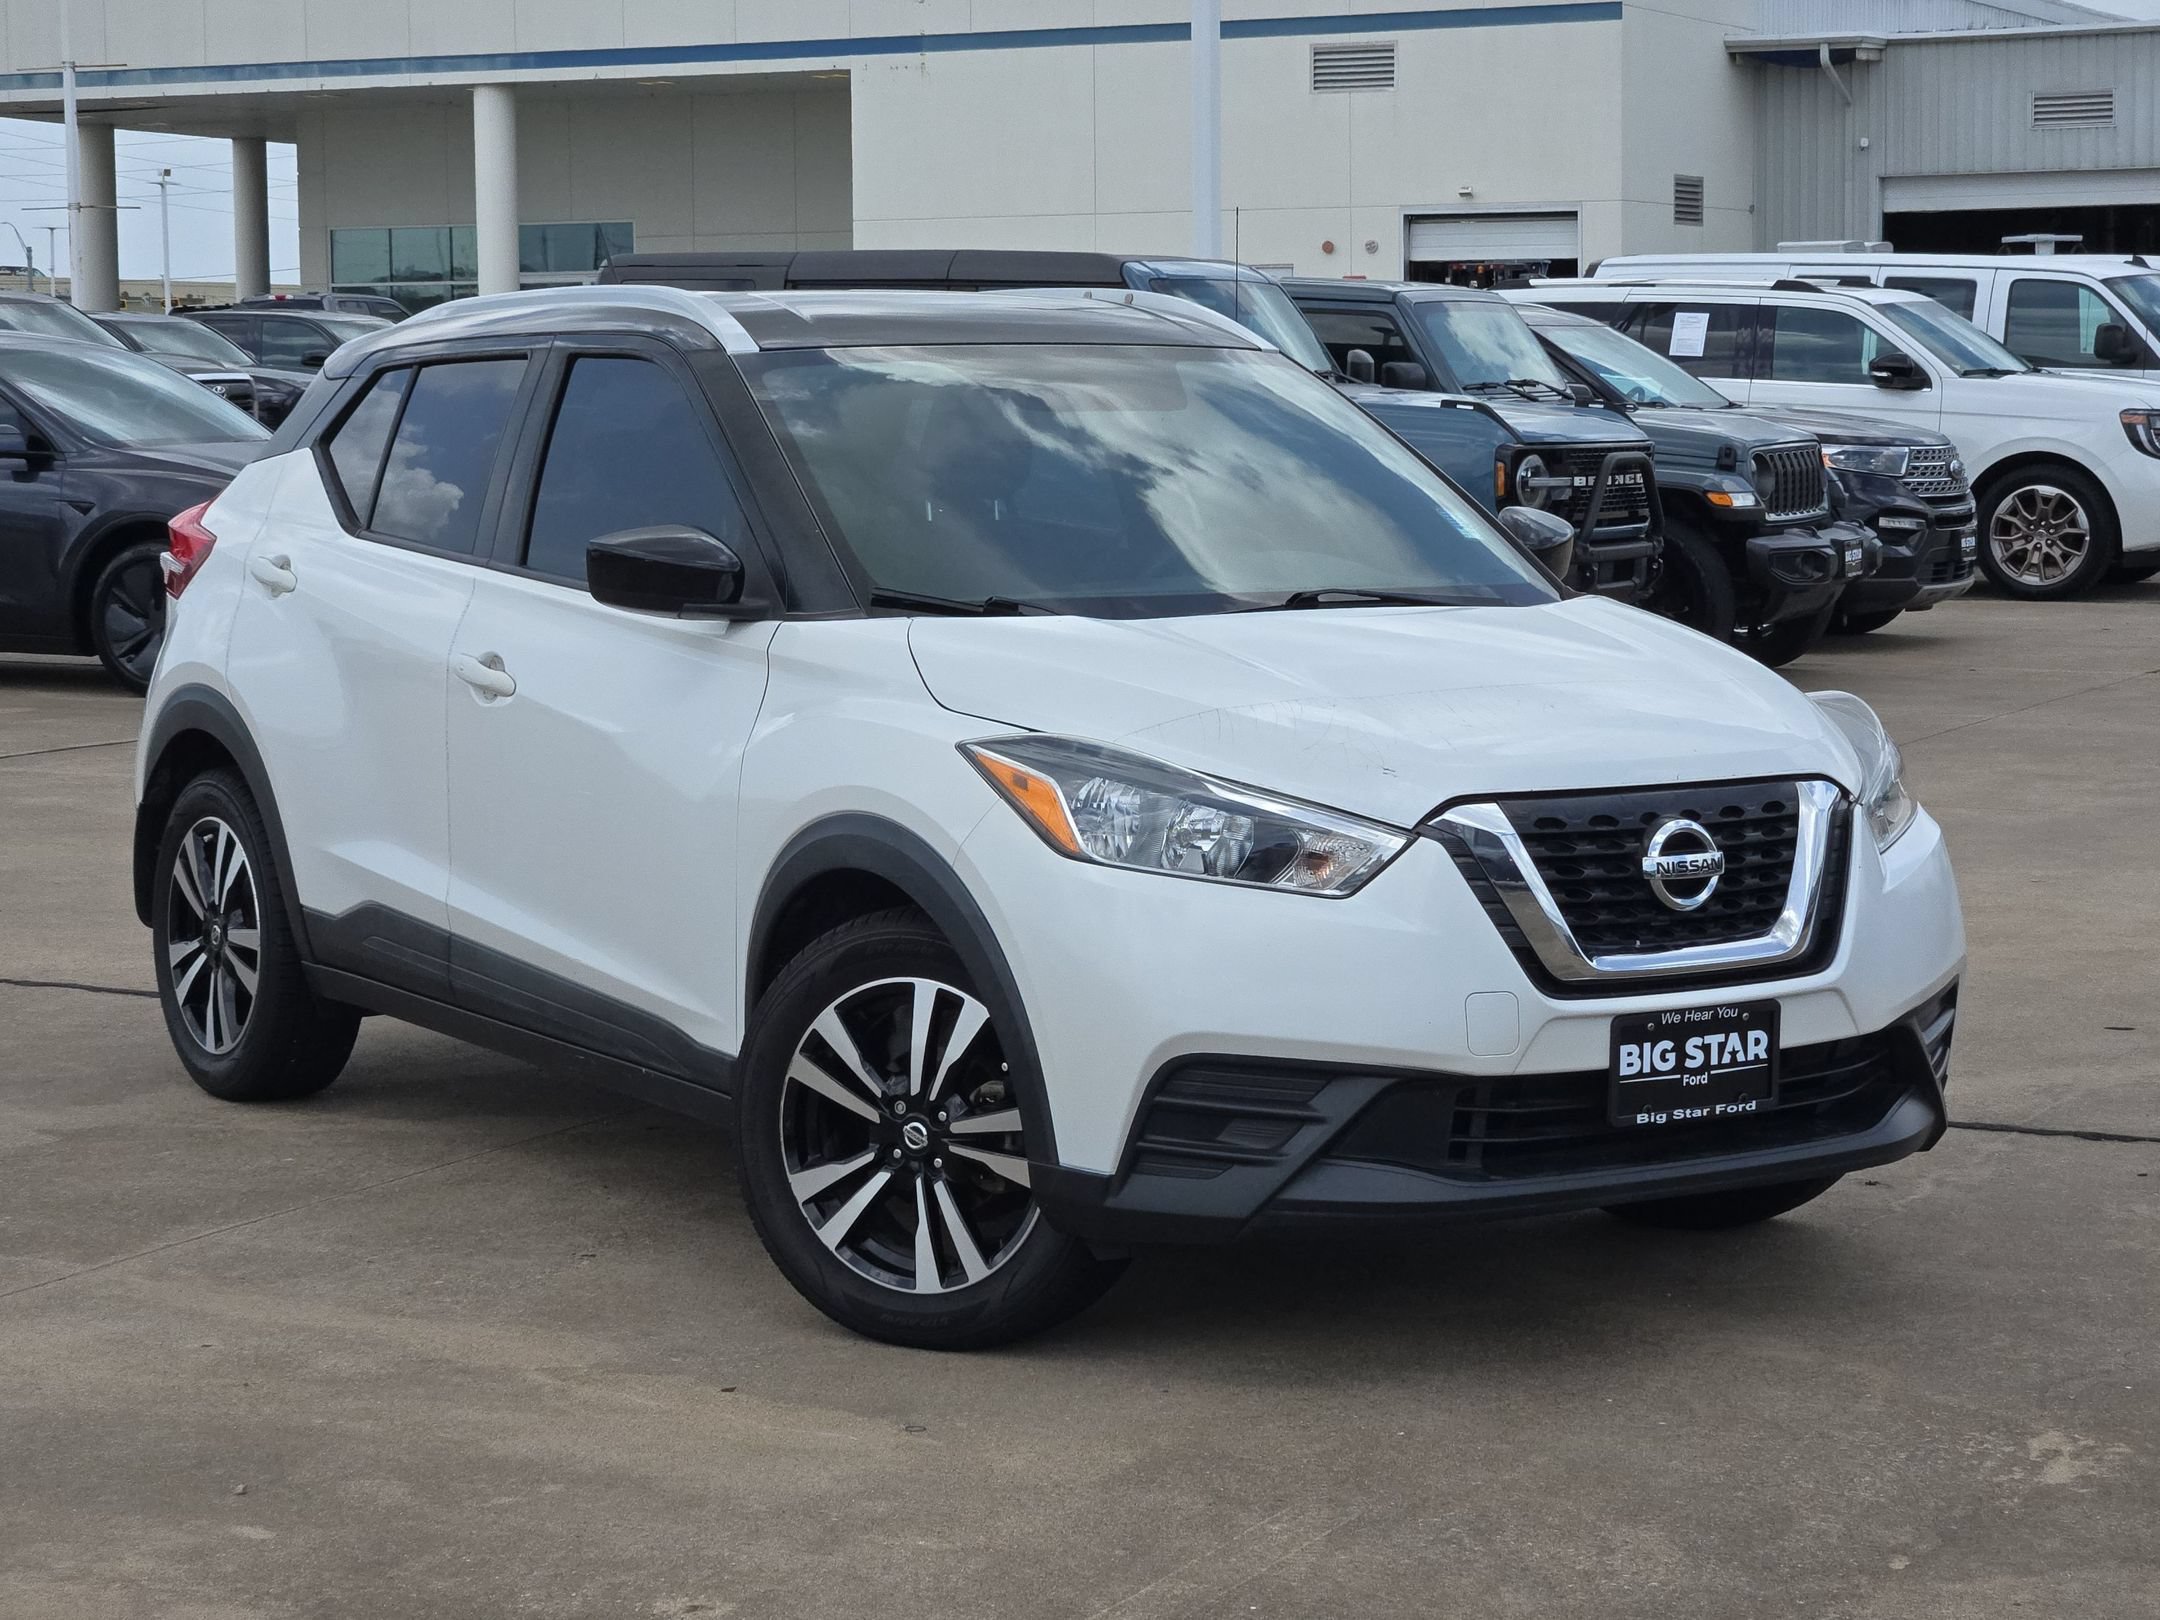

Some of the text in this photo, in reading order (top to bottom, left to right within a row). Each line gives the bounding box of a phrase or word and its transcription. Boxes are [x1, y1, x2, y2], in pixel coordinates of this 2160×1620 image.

[1656, 858, 1722, 875] NISSAN
[1661, 1007, 1739, 1025] We Hear You
[1619, 1030, 1768, 1076] BIG STAR
[1683, 1072, 1708, 1086] Ford
[1636, 1100, 1757, 1124] Big Star Ford
